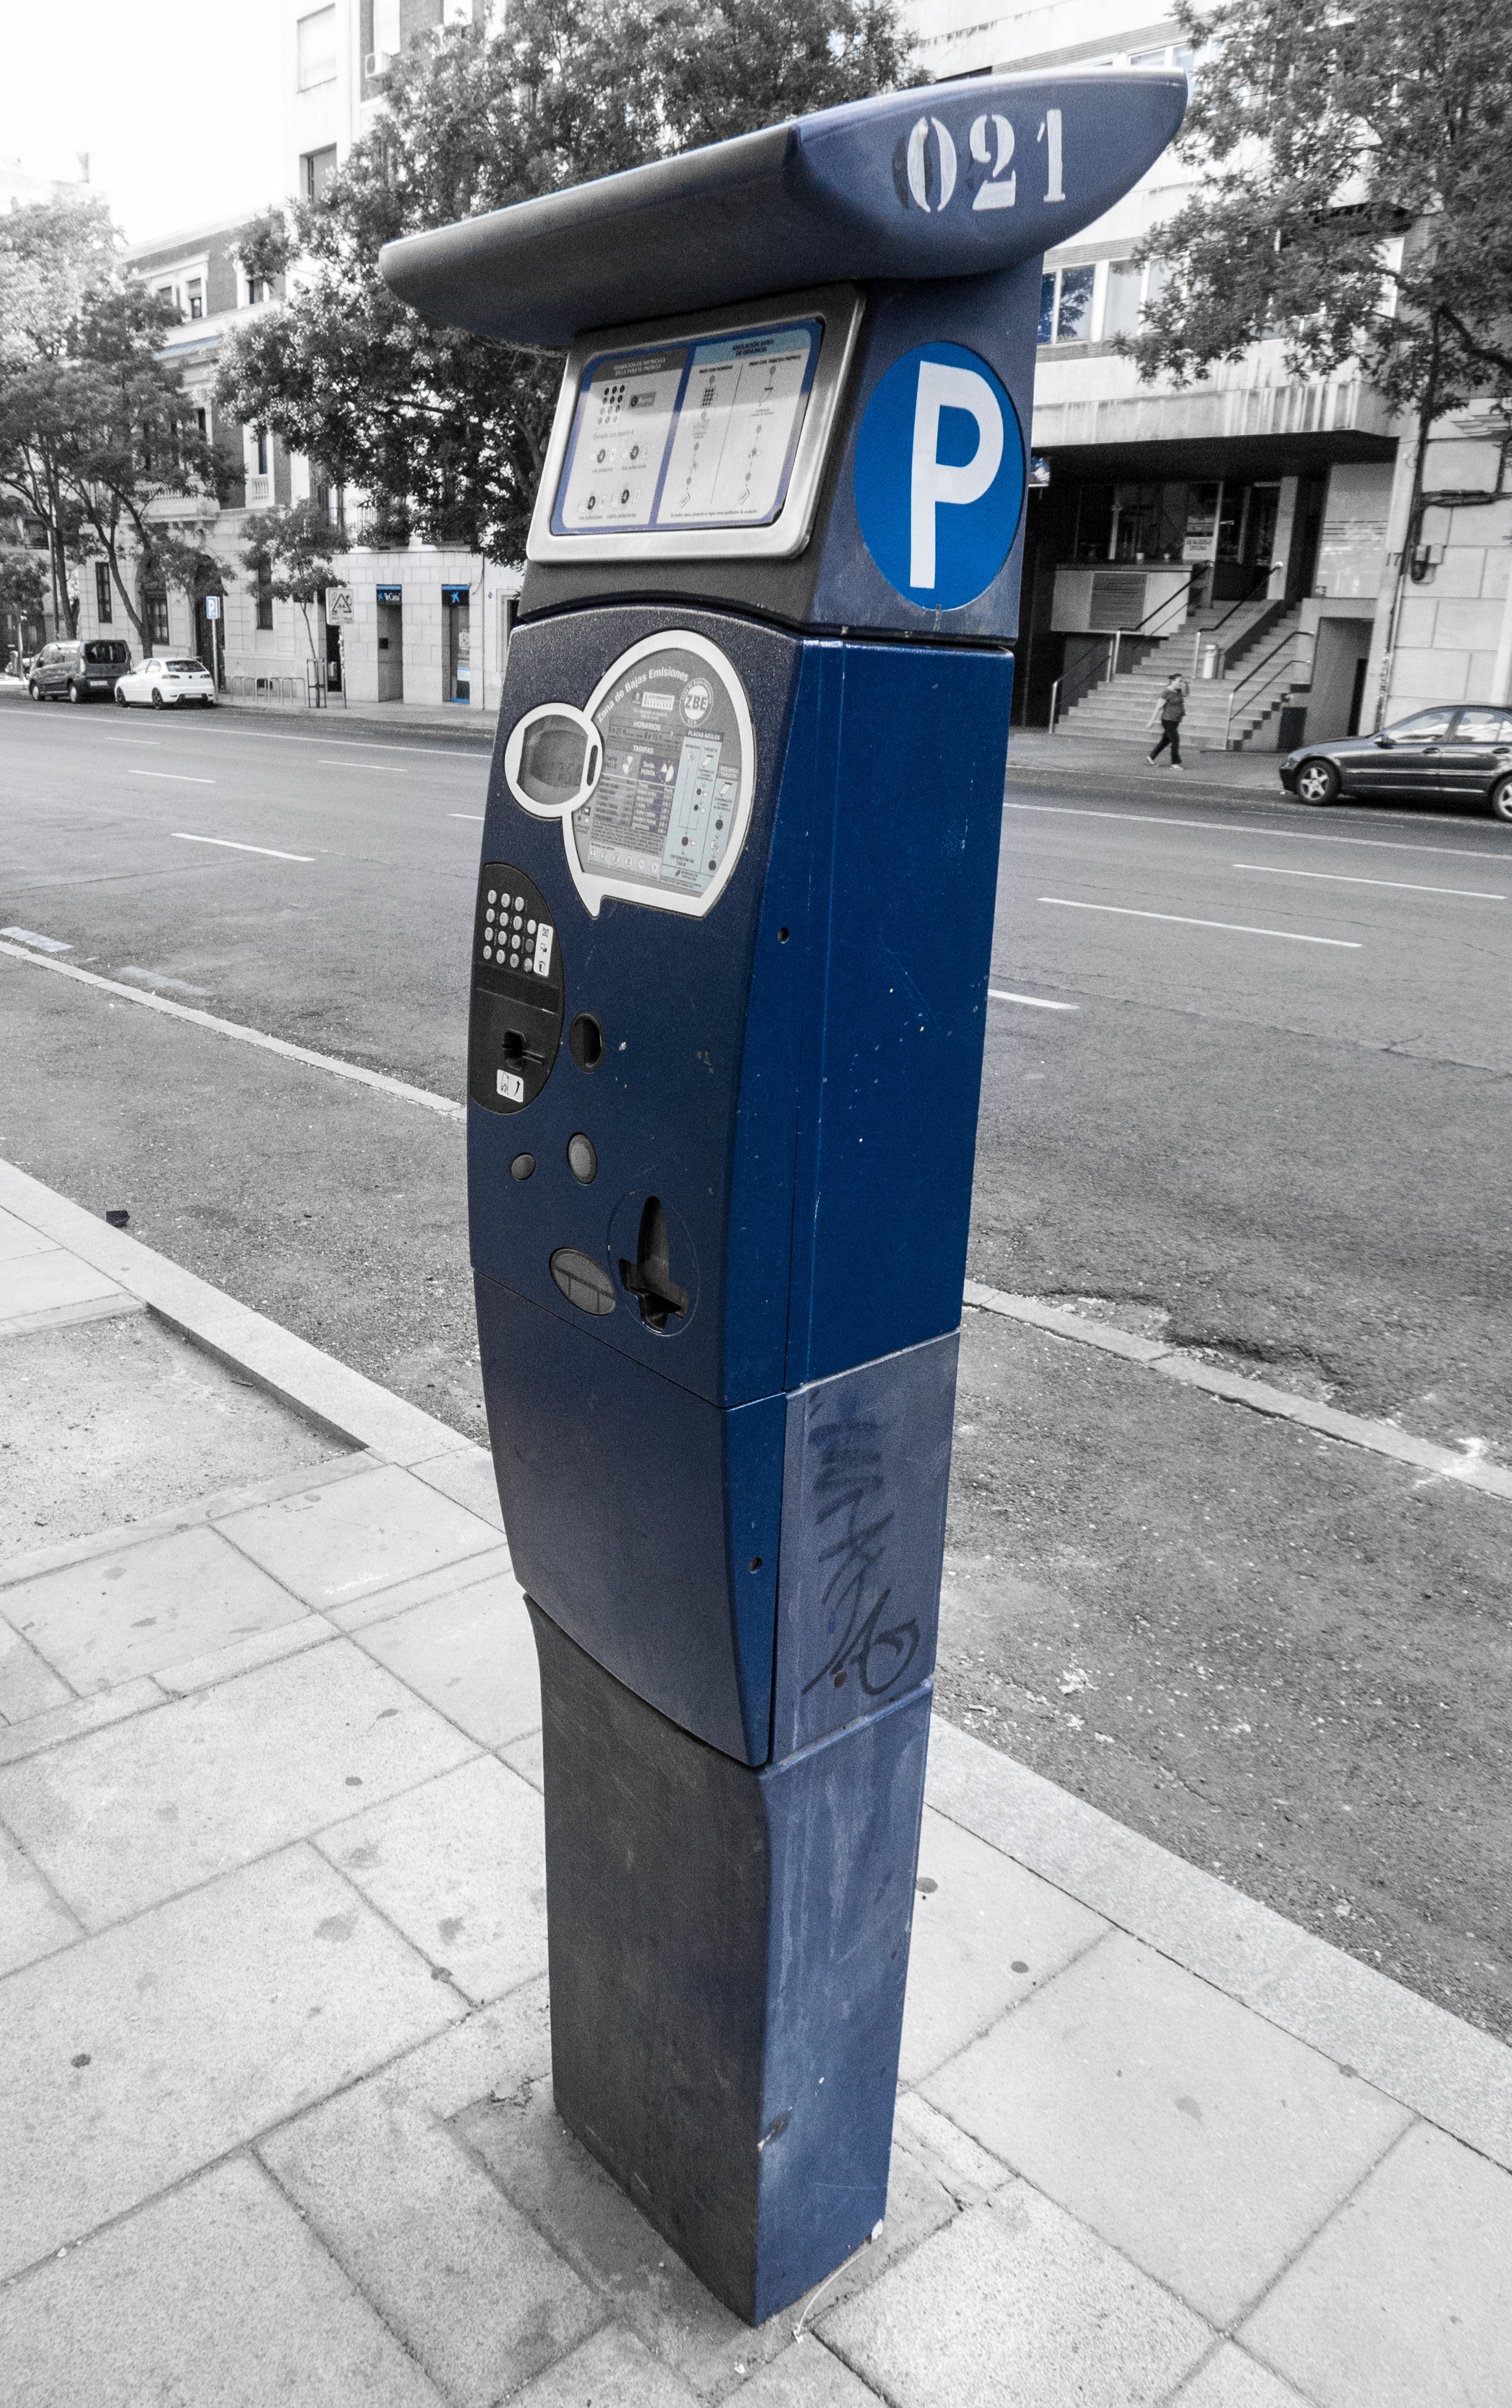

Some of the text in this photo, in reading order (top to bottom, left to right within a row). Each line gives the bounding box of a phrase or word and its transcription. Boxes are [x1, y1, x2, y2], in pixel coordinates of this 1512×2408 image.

[906, 108, 1065, 213] 021
[910, 361, 1004, 589] P
[208, 599, 215, 616] P
[597, 700, 615, 723] Zona
[615, 689, 625, 704] de
[624, 674, 647, 693] Bajas
[648, 667, 689, 682] Emisiones
[685, 695, 707, 711] ZBE
[633, 721, 661, 732] HORARIOS
[633, 745, 654, 754] TARIFAS
